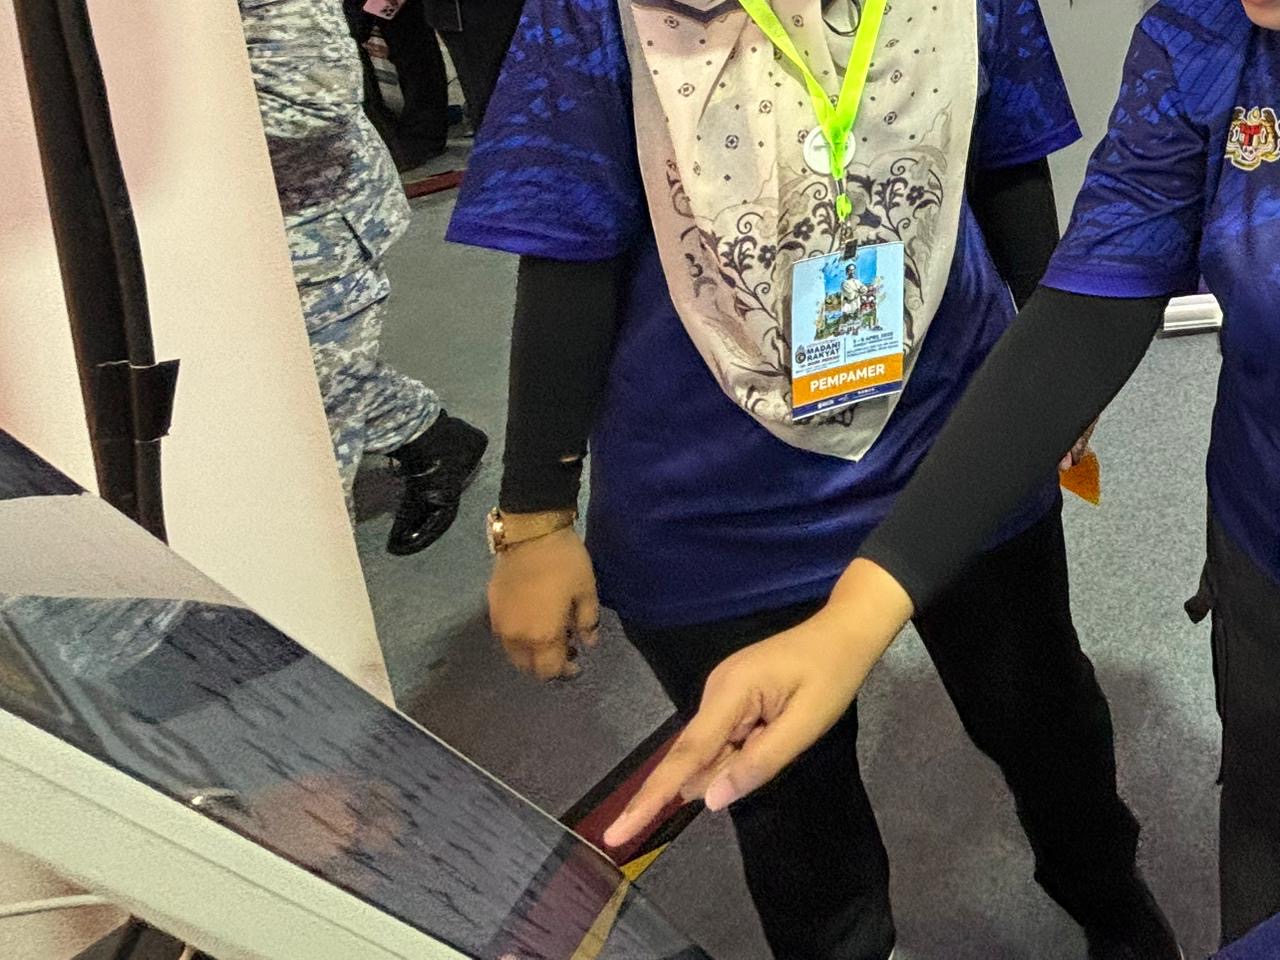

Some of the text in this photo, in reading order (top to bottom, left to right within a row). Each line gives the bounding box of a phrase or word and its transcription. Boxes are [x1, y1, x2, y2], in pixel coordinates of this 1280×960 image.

[806, 341, 841, 356] MADANI
[806, 348, 841, 362] RAKYAT
[810, 364, 886, 393] PEMPAMER
